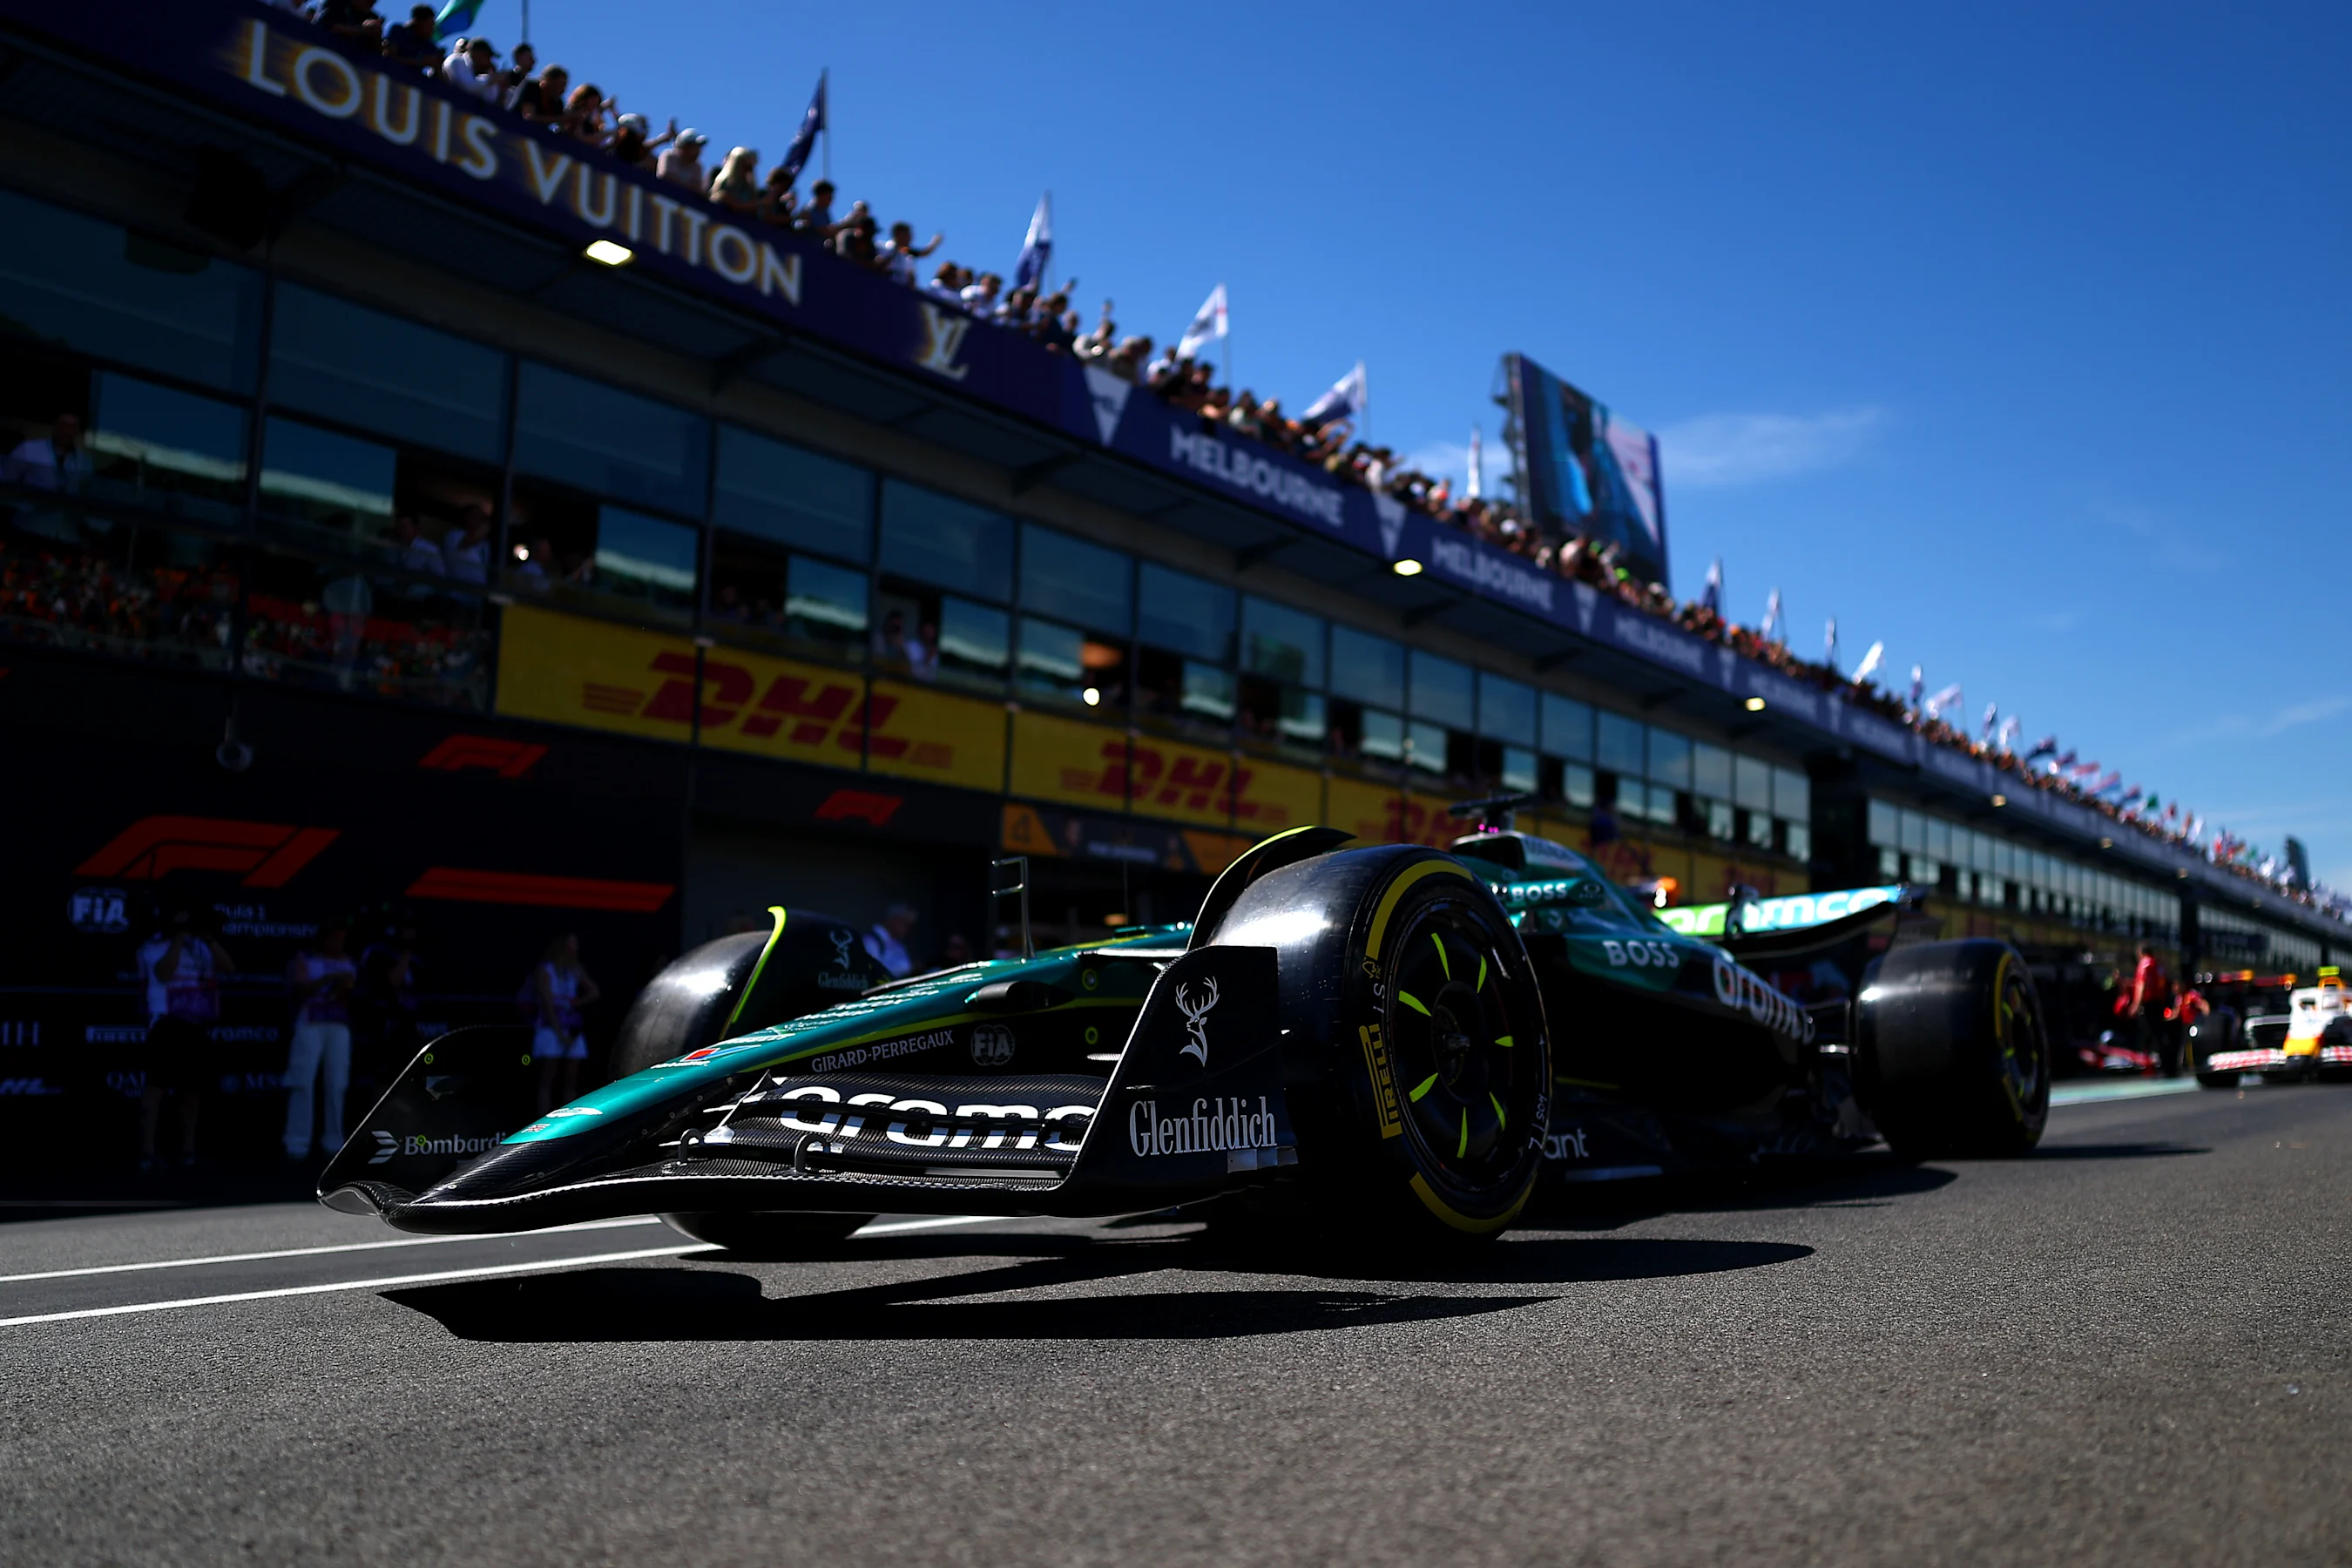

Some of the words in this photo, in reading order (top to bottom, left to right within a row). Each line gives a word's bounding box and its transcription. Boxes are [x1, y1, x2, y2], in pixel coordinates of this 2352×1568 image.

[243, 17, 499, 181] LOUIS
[521, 135, 803, 308] VUITTON
[1169, 422, 1344, 529] MELBOURNE
[1431, 535, 1554, 612] MELBOURNE
[641, 651, 909, 757] DHL
[1098, 741, 1259, 819] DHL
[70, 891, 130, 928] FIA
[1511, 882, 1568, 902] BOSS
[817, 970, 868, 990] Glenfiddich
[1602, 939, 1680, 968] BOSS
[1713, 958, 1816, 1044] aramco
[811, 1030, 955, 1072] GIRARD-PERREGAUX
[972, 1030, 1014, 1059] FIA
[1359, 1024, 1403, 1139] PIRELLI
[1129, 1095, 1278, 1157] Glenfiddich
